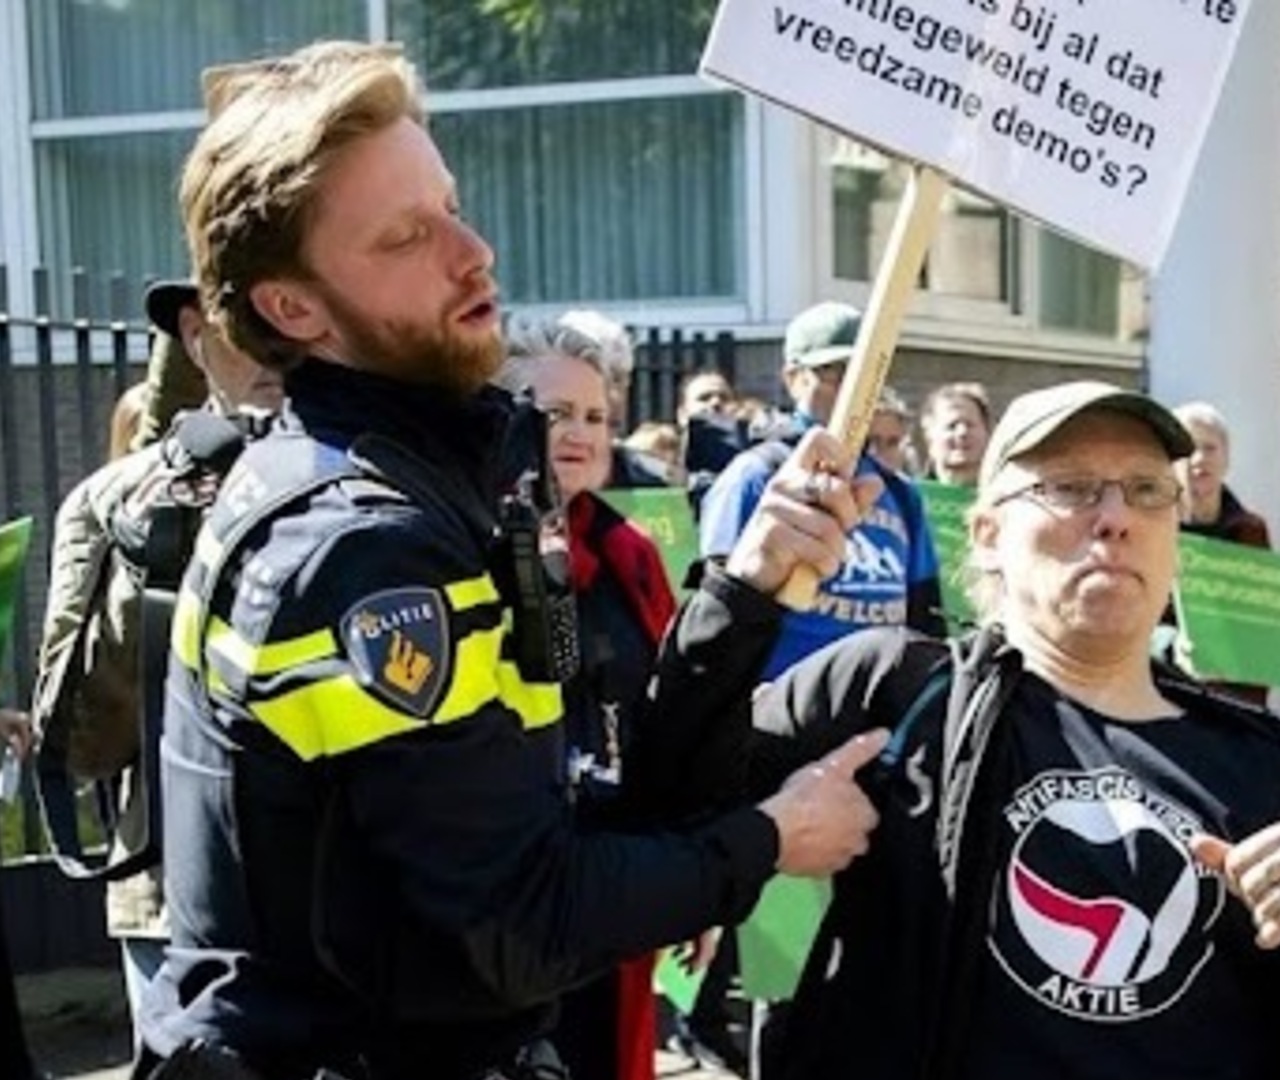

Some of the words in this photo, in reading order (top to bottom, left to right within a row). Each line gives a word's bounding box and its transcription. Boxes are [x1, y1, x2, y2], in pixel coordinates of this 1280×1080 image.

[774, 6, 982, 118] vreedzame
[991, 104, 1148, 196] demo's?
[842, 0, 1050, 97] tiegeweld
[1055, 77, 1156, 151] tegen
[1009, 0, 1057, 51] bij
[1063, 32, 1099, 66] al
[1105, 50, 1165, 99] dat
[1039, 974, 1142, 1013] AKTIE
